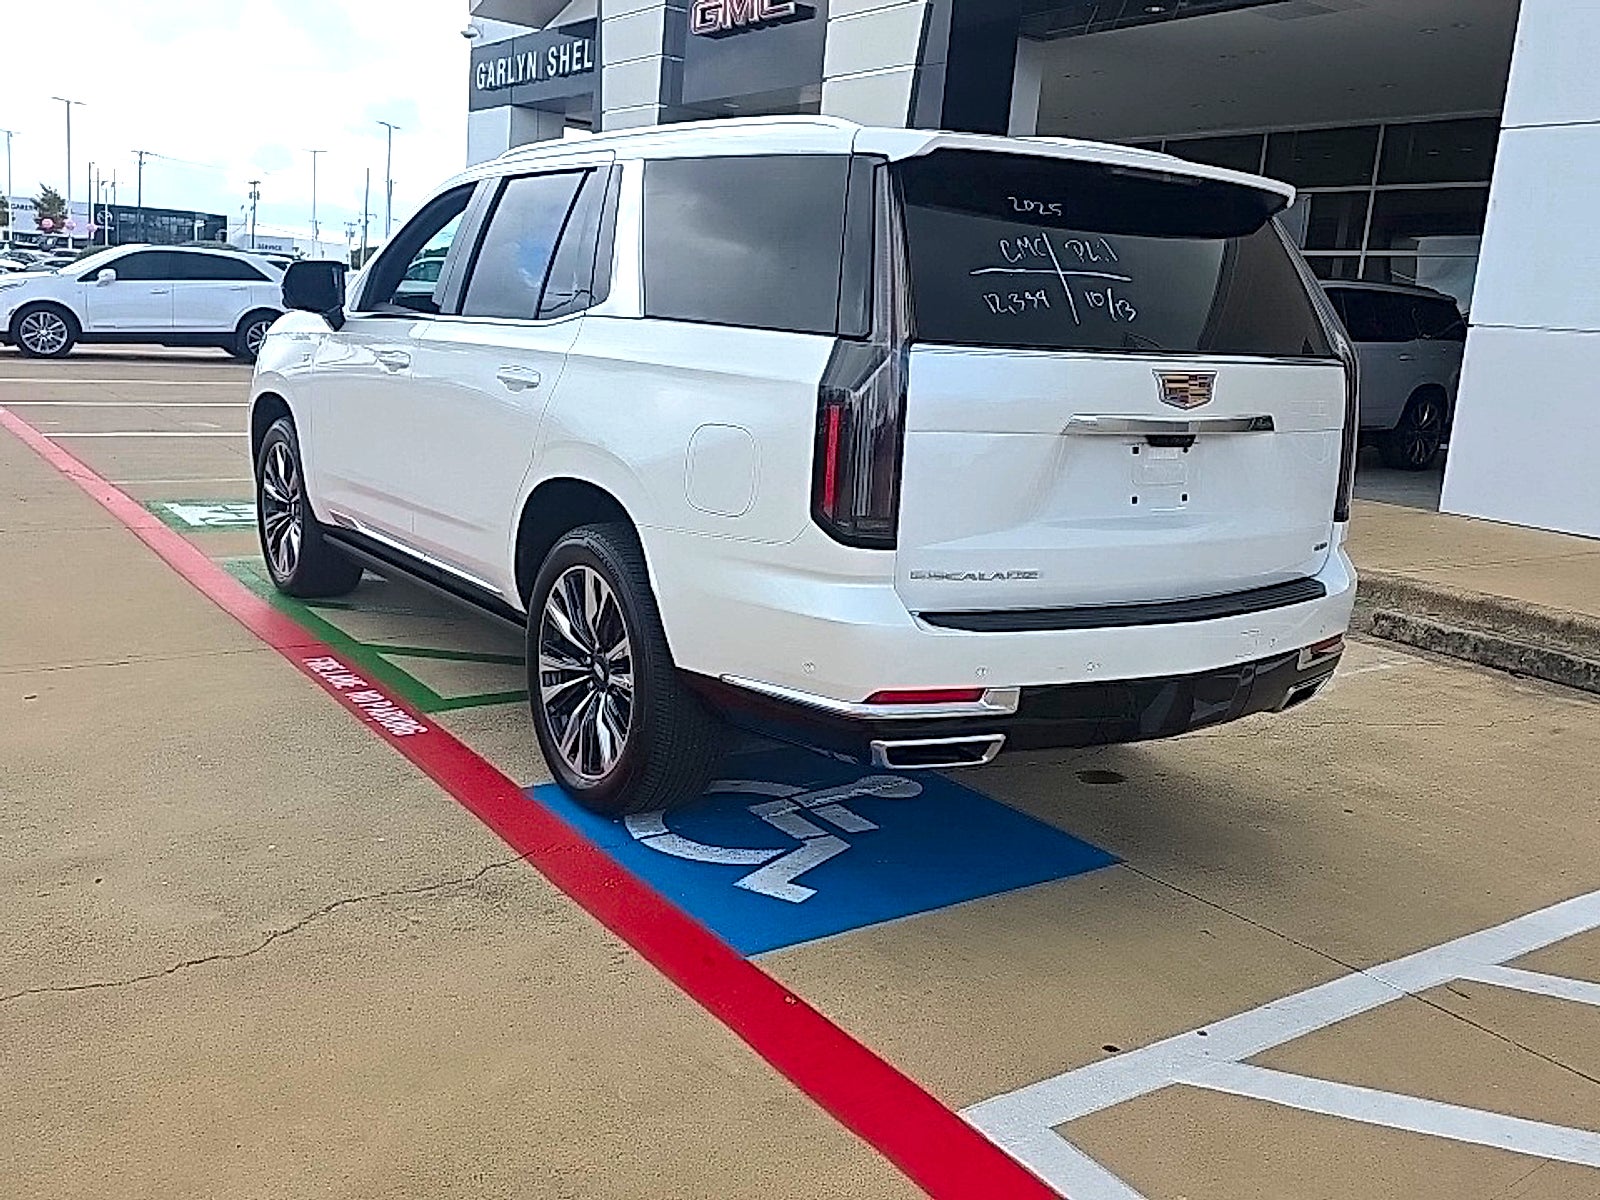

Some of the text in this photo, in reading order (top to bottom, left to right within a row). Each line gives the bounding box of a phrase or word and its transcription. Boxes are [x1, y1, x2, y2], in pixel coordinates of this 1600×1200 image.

[691, 0, 796, 34] GMC
[476, 38, 593, 89] GARLYN SHEL
[1008, 196, 1063, 216] 2025
[1083, 287, 1137, 321] 10/13
[909, 569, 1040, 582] ESCALADE
